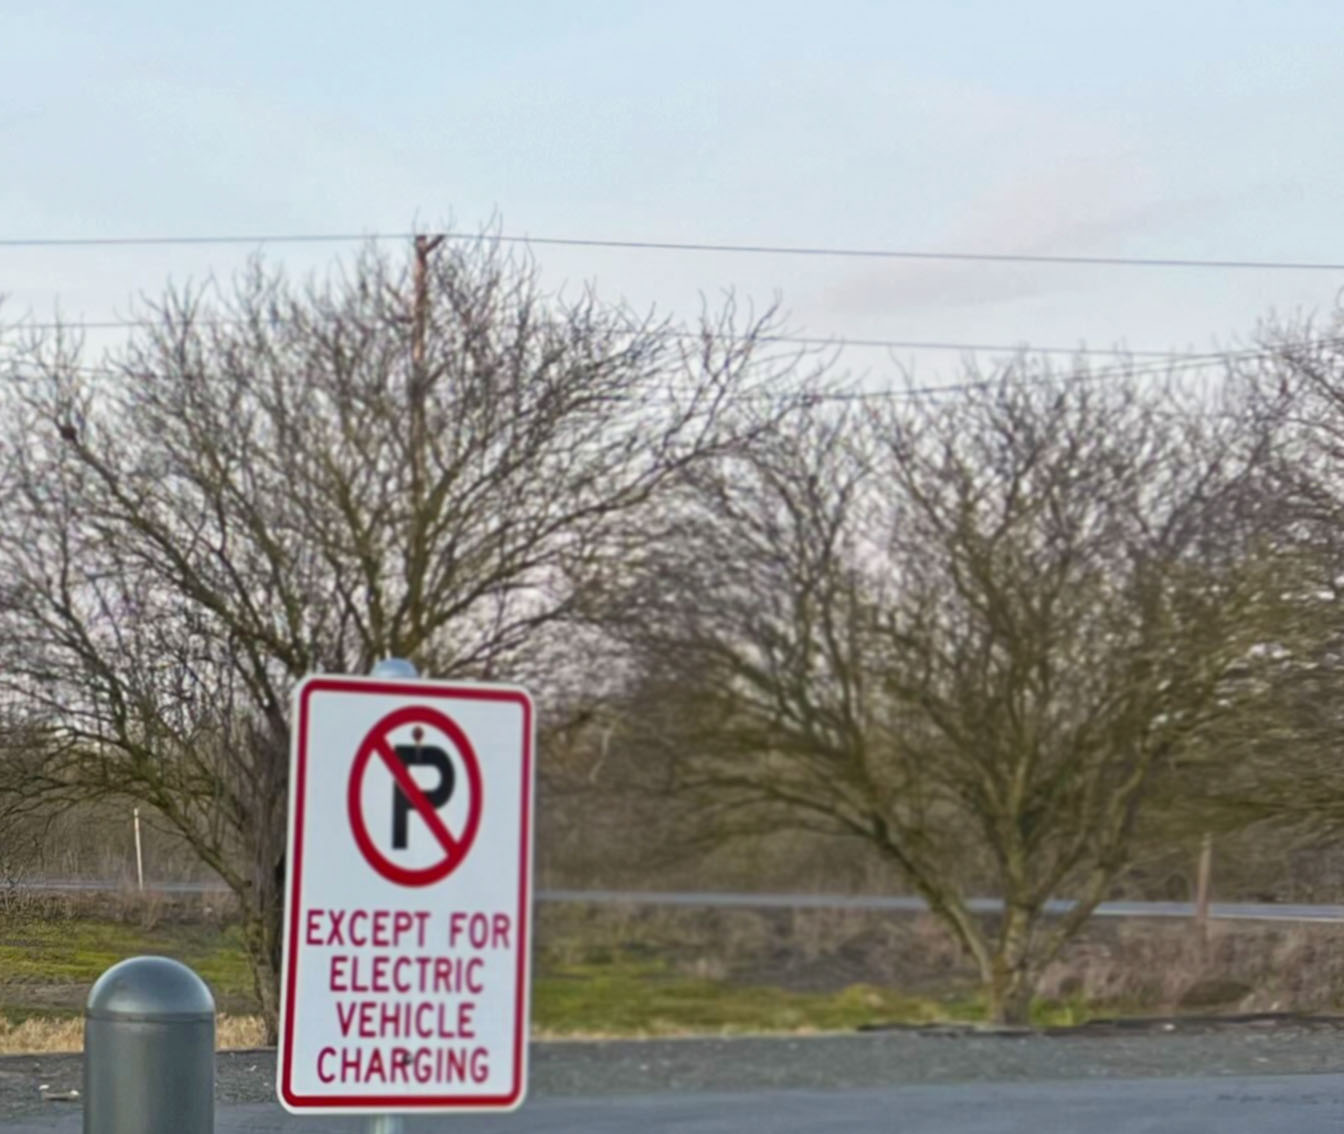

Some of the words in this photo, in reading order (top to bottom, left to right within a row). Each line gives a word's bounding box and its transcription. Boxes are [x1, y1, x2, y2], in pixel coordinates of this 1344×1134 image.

[305, 908, 431, 948] EXCEPT
[448, 911, 511, 949] FOR
[329, 955, 485, 994] ELECTRIC
[335, 1001, 476, 1039] VEHICLE
[316, 1046, 490, 1084] CHARGING
